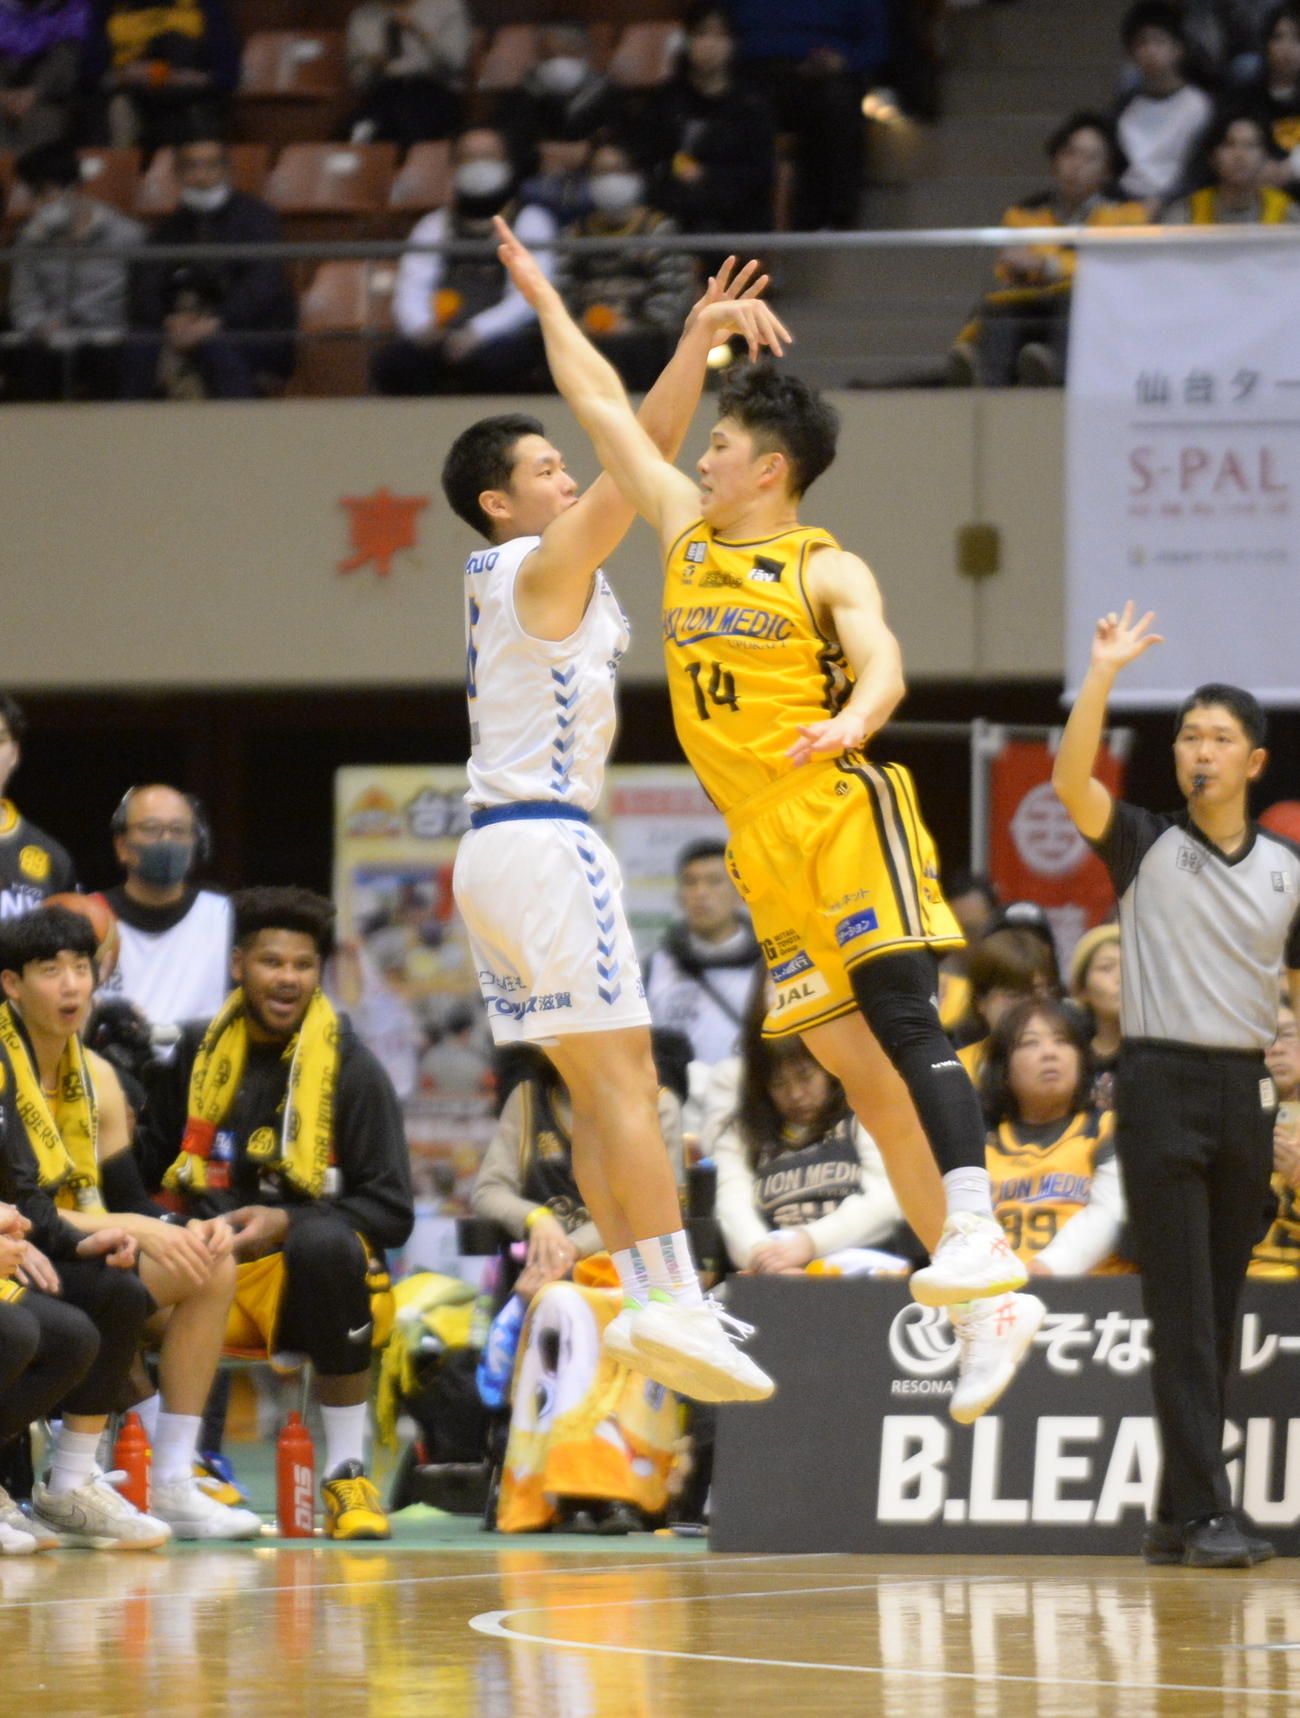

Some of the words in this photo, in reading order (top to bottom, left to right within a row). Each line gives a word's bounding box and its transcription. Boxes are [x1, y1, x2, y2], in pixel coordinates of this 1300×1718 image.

[717, 606, 794, 641] MEDIC
[685, 661, 741, 720] 14
[776, 983, 816, 1010] JAL
[891, 1379, 955, 1394] RESONA
